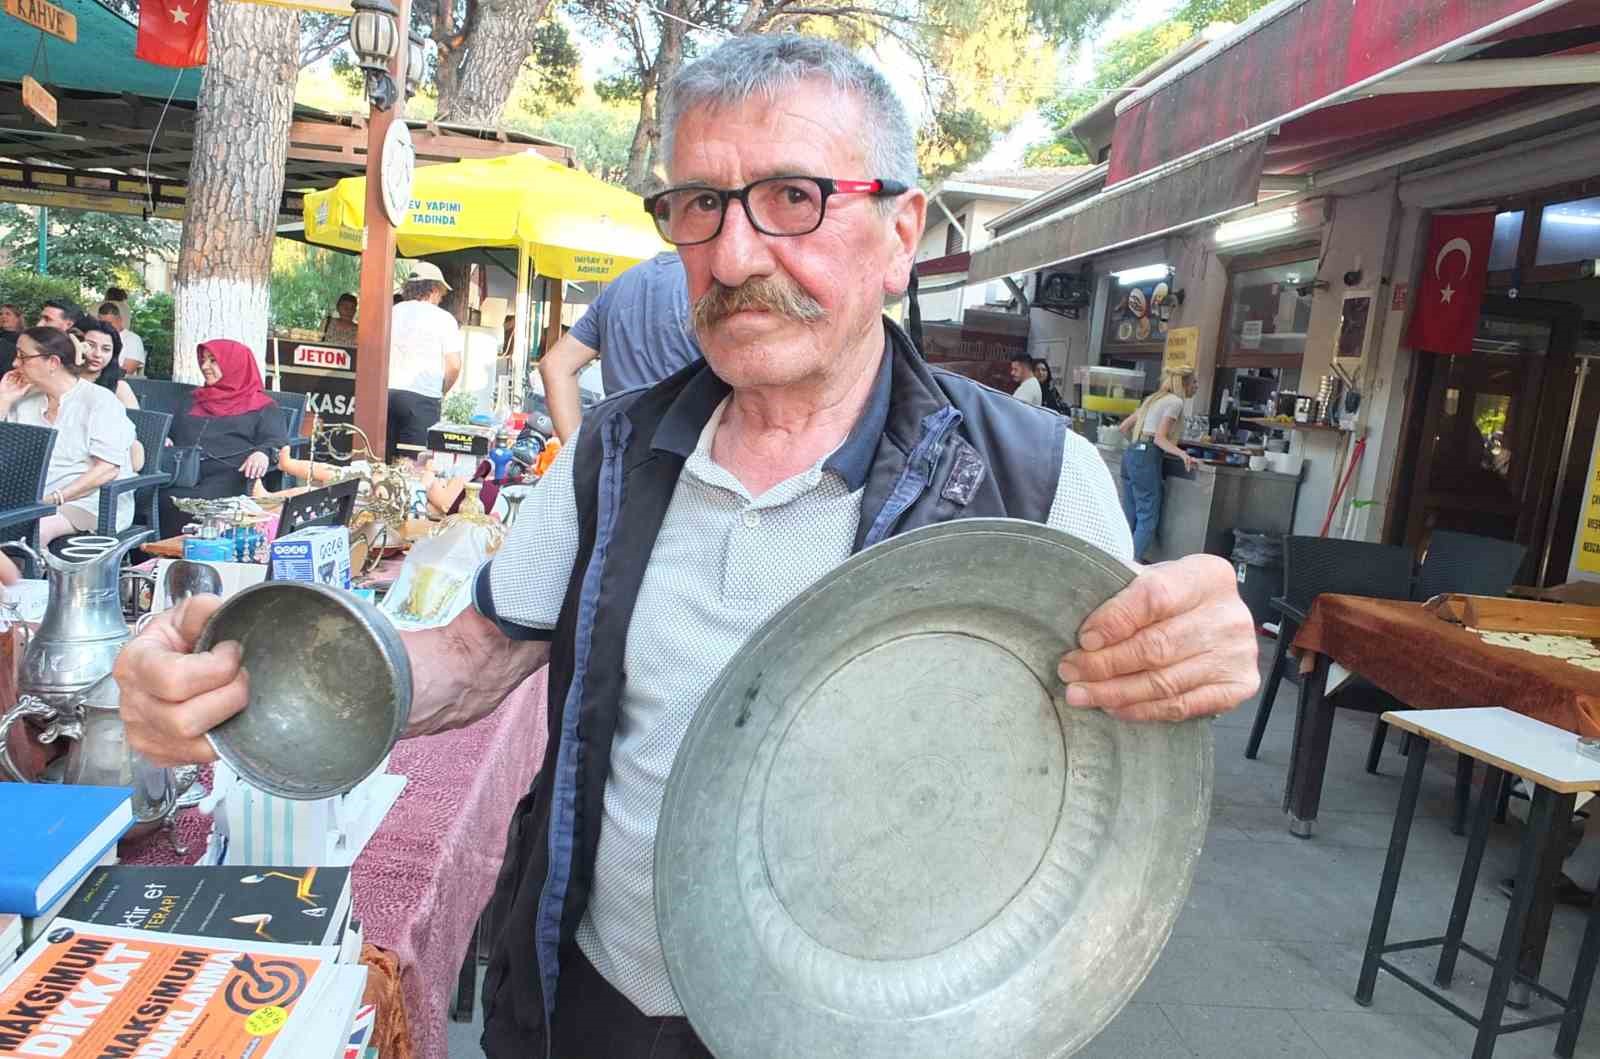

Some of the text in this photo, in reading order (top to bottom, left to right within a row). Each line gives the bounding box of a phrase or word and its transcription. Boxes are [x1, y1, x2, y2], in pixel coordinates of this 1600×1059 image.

[17, 0, 66, 35] KAHVE
[299, 349, 347, 366] JETON
[144, 883, 167, 899] et
[133, 952, 242, 1059] DAKLANMA
